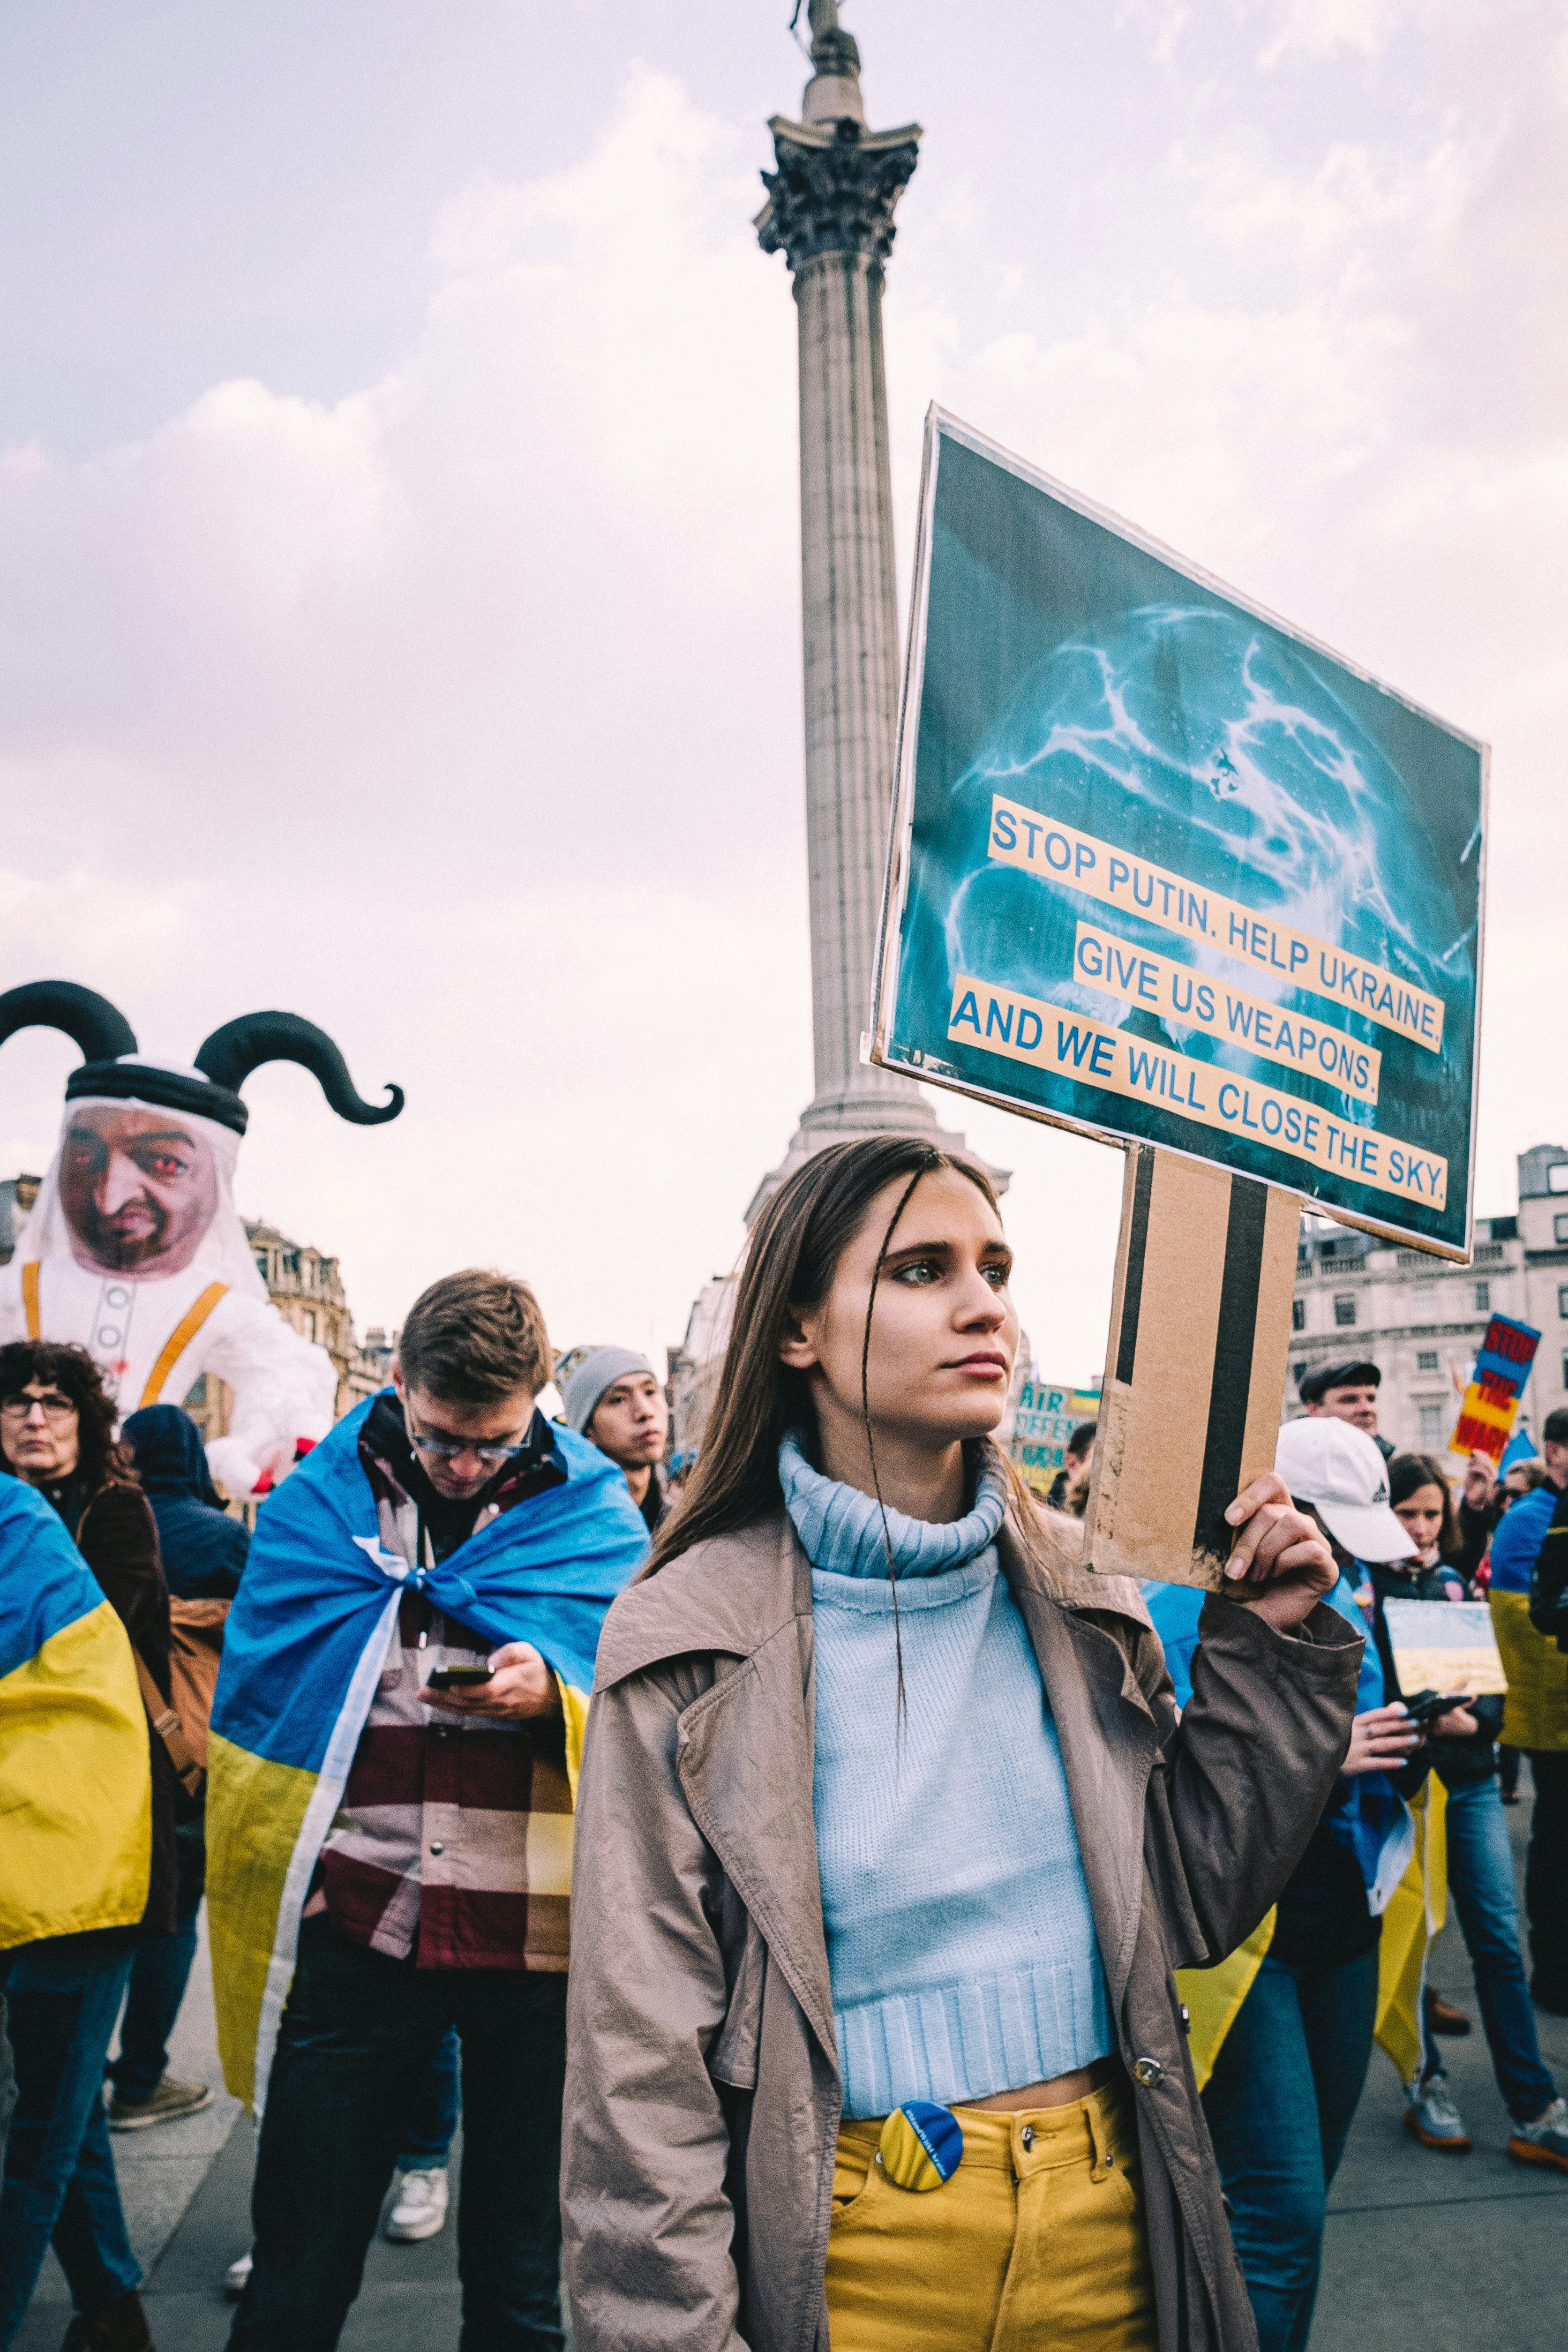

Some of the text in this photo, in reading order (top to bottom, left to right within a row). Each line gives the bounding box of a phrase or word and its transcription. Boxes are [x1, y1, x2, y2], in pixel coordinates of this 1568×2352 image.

[992, 809, 1439, 1042] STOP PUTIN. HELP UKRAINE.
[1077, 937, 1375, 1093] GIVE US WEAPONS.
[950, 991, 1444, 1199] AND WE WILL CLOSE THE SKY.
[1478, 1370, 1517, 1411] THE
[1485, 1321, 1537, 1364] STOP
